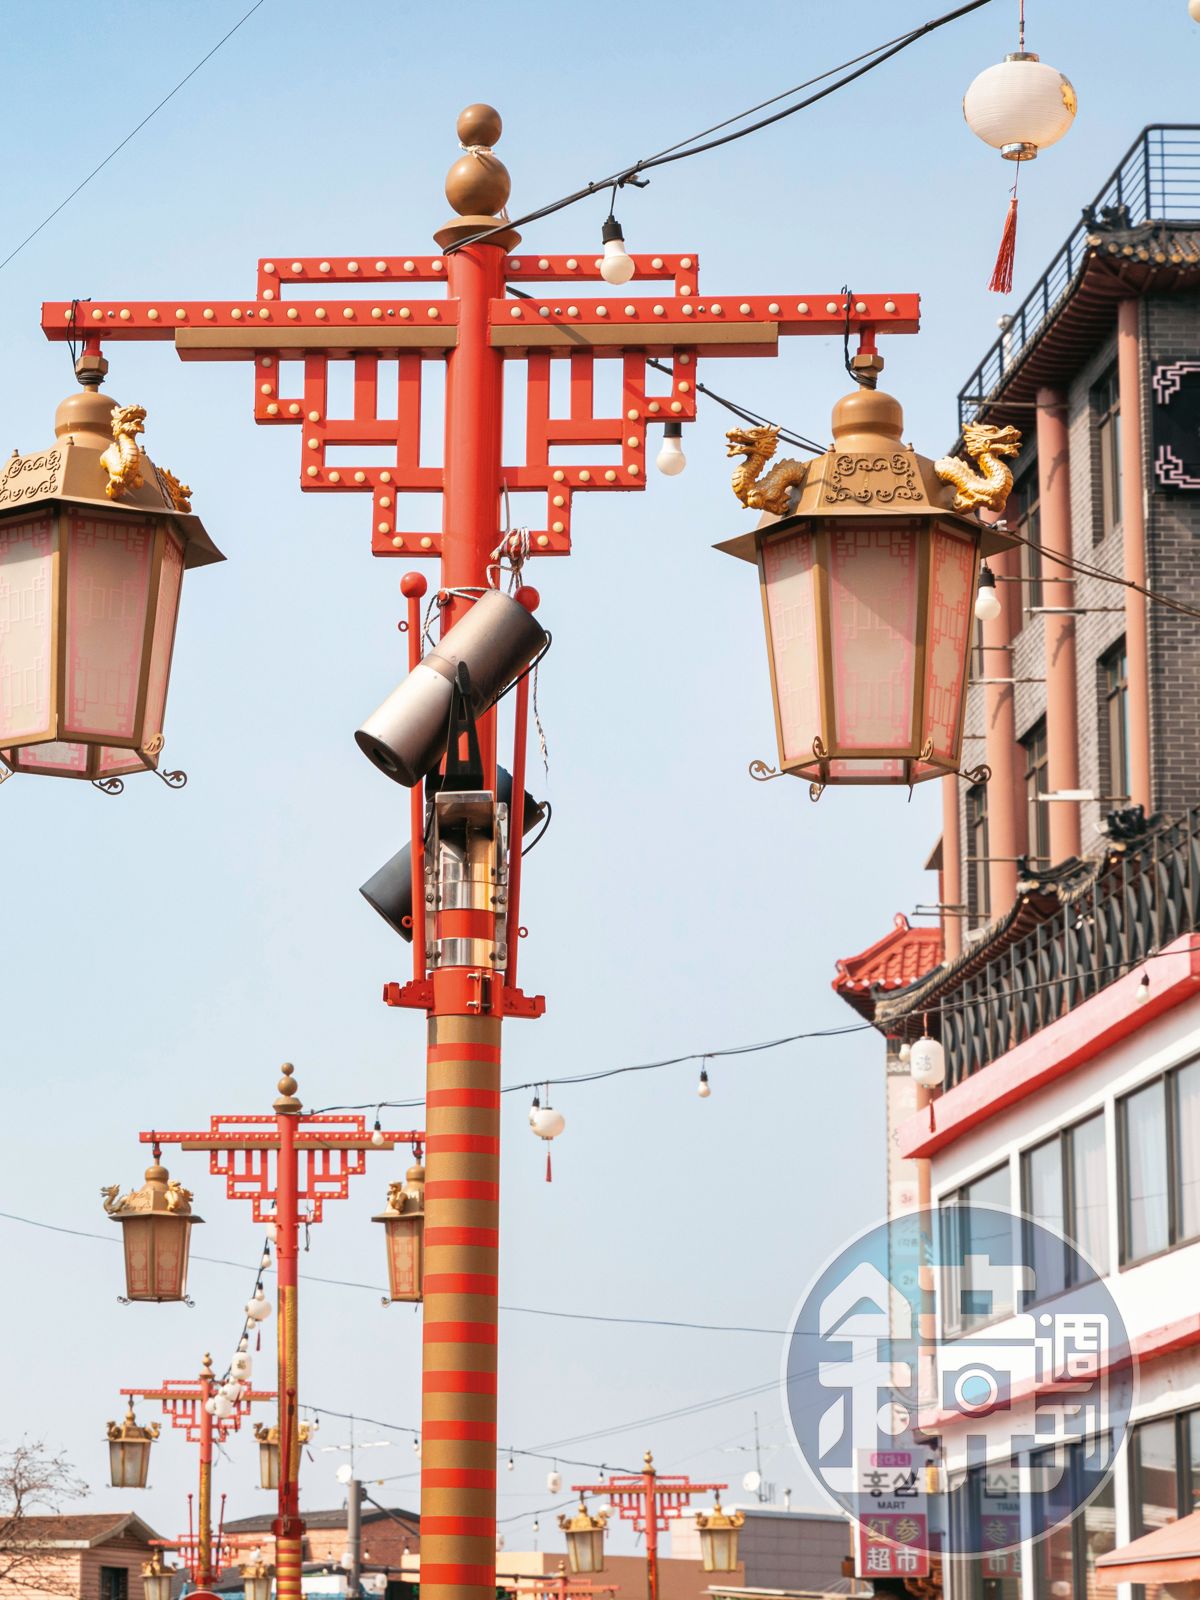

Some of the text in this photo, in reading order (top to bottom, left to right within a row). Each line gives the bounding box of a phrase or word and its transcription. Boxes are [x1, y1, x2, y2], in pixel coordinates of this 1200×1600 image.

[863, 1470, 920, 1498] 홍삼
[877, 1501, 906, 1510] MART
[867, 1519, 921, 1543] 红参
[867, 1547, 919, 1572] 超市
